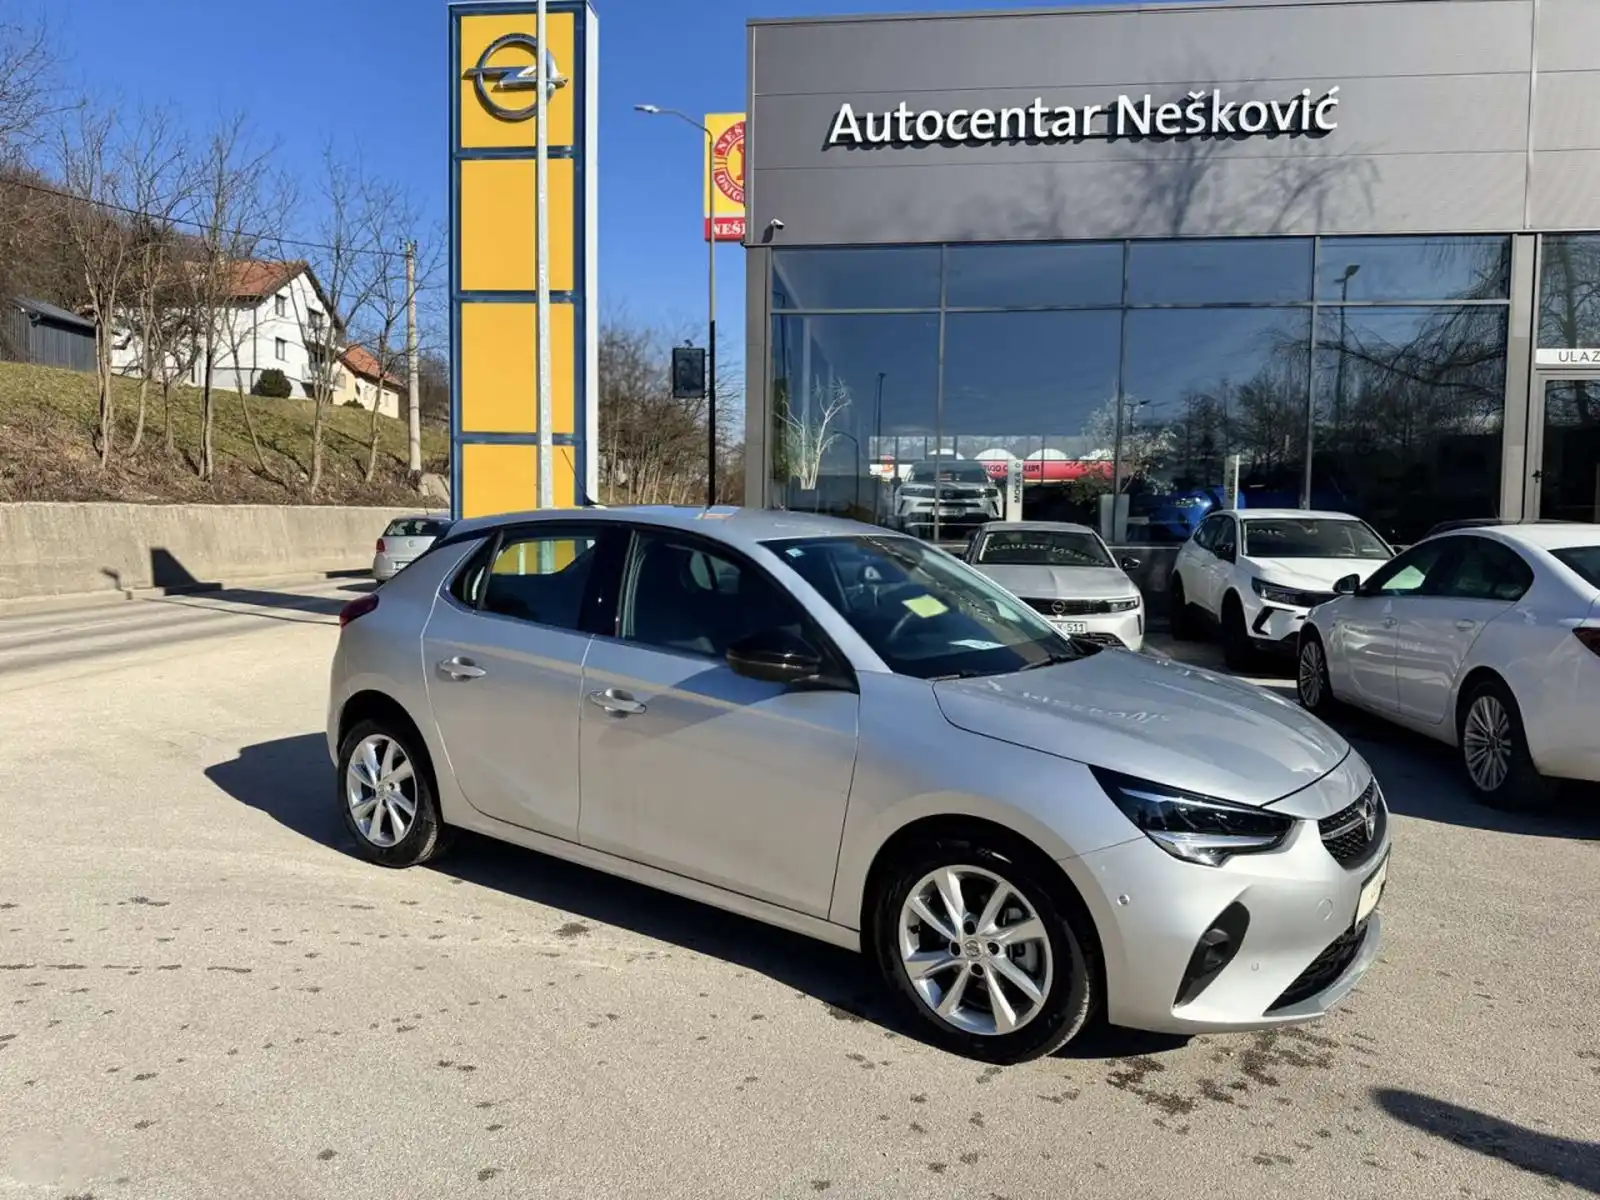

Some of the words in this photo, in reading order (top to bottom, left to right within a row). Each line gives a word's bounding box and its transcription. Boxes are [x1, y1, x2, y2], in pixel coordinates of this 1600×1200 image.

[829, 97, 1102, 143] Autocentar
[1116, 85, 1340, 136] Nešković
[1558, 350, 1600, 362] ULAZ
